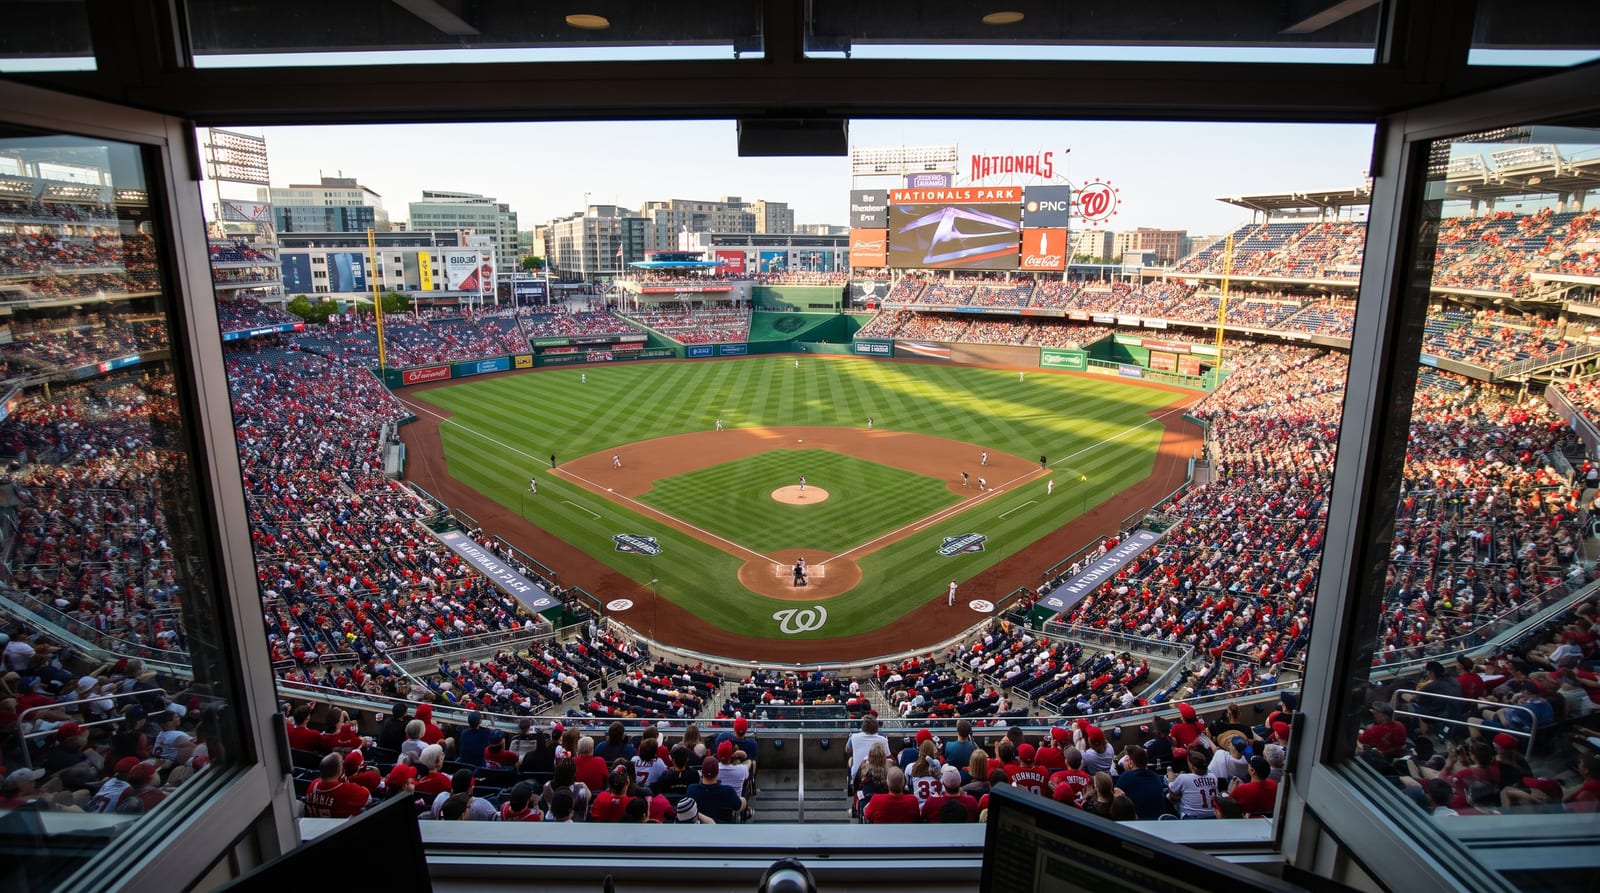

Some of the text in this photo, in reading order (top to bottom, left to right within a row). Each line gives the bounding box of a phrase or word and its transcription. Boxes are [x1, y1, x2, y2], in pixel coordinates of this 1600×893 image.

[971, 152, 1053, 182] NATIONALS
[894, 189, 1014, 200] NATIONALS PARK
[1039, 201, 1067, 211] PNC
